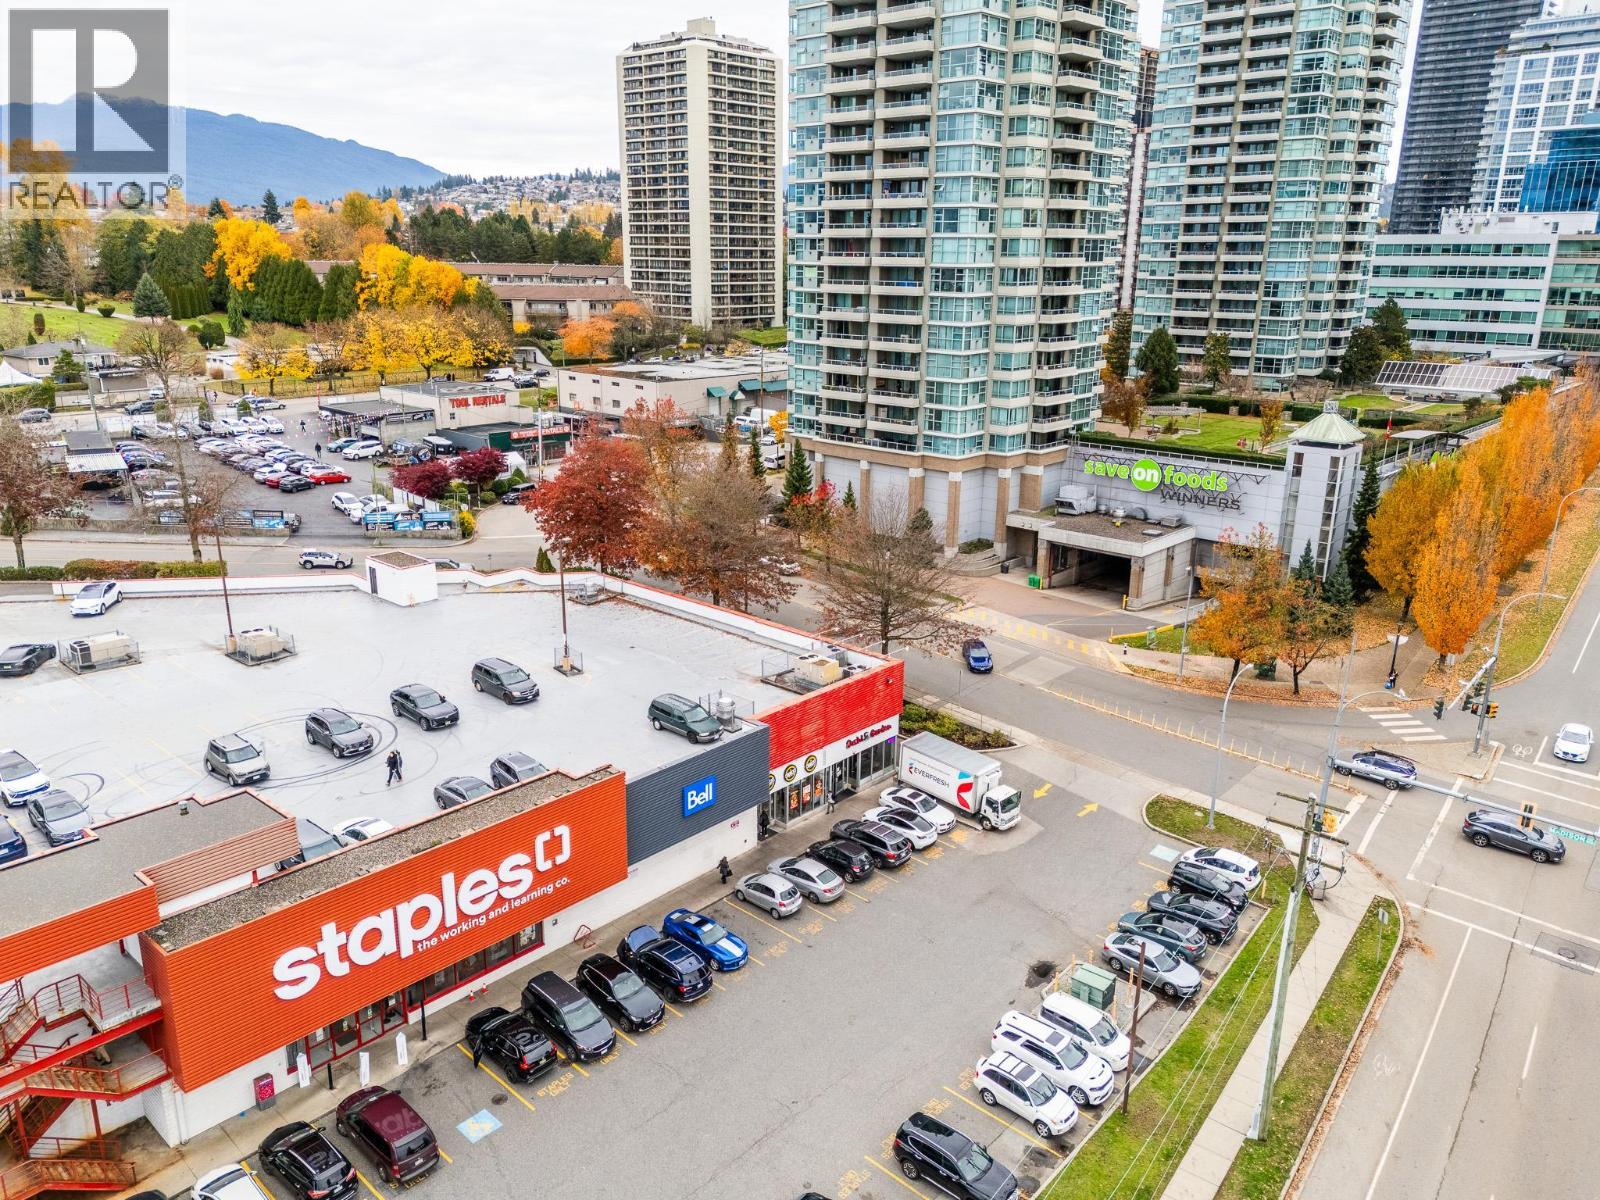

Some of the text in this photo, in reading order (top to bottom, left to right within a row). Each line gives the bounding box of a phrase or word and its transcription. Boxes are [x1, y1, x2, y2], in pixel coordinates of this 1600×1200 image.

[450, 394, 506, 408] TOOL RENTALS
[1084, 460, 1228, 491] save on foods
[1161, 488, 1240, 510] WINNERS
[914, 767, 950, 788] EVERFRESH
[687, 783, 713, 810] Bell
[272, 853, 534, 1000] staples
[417, 876, 570, 952] the working and learning co.
